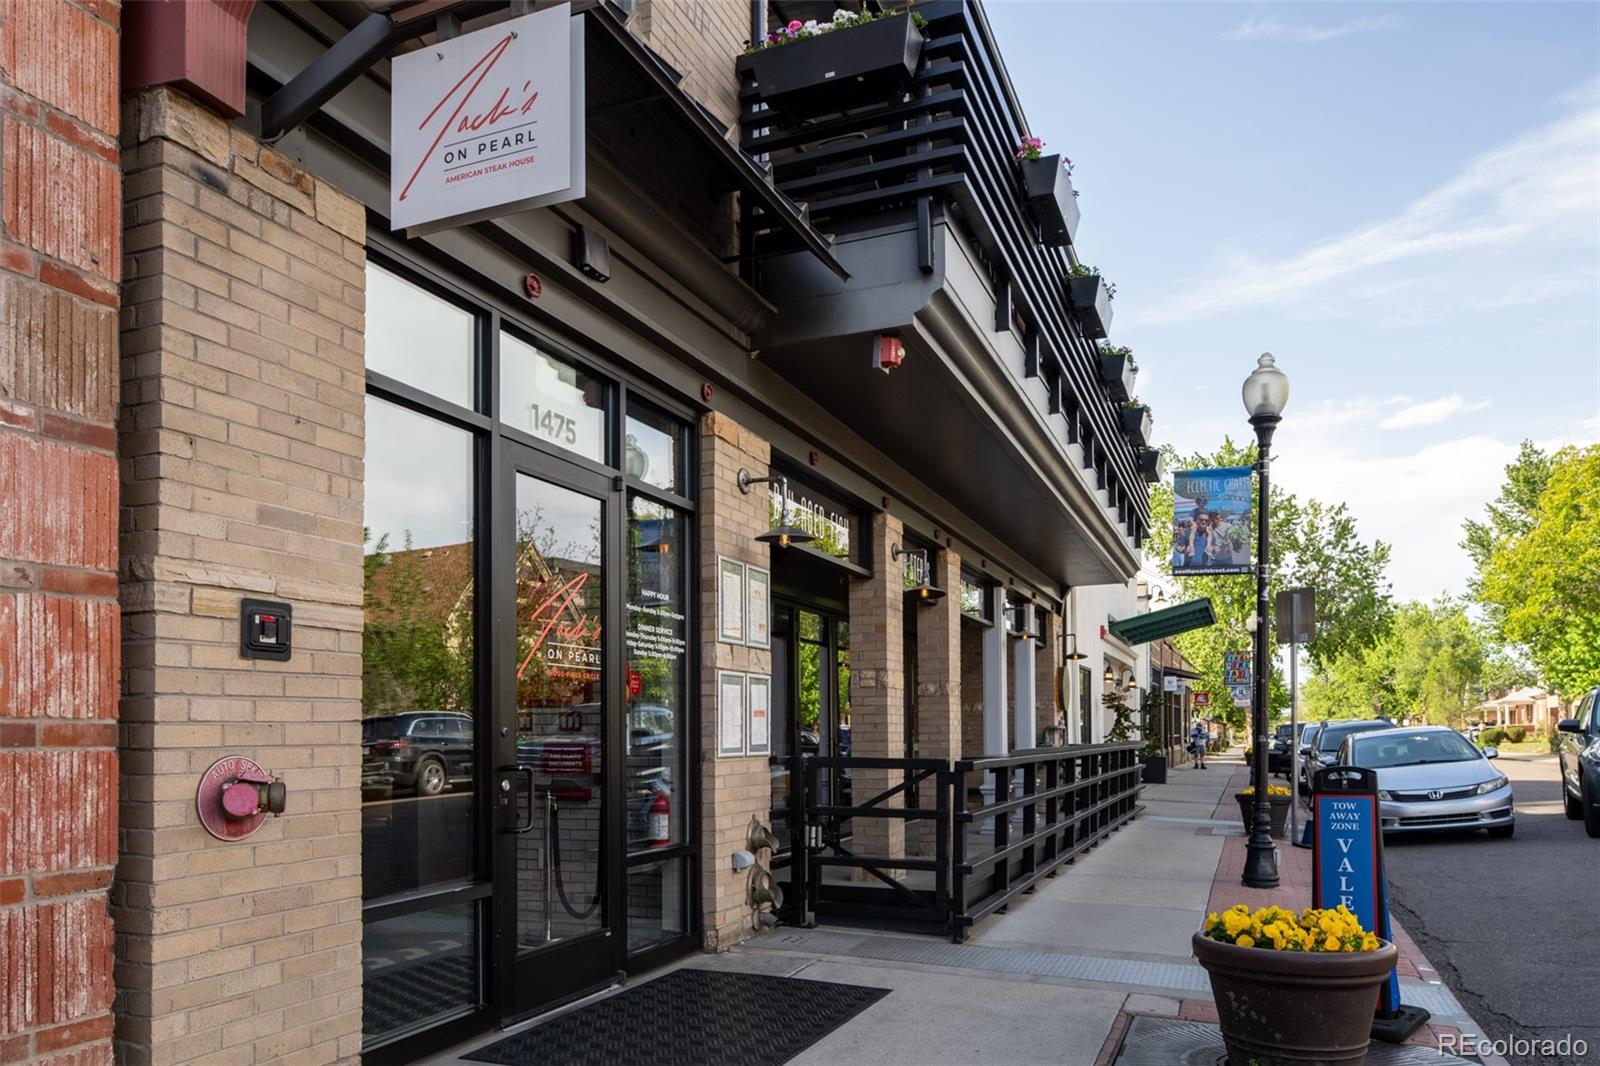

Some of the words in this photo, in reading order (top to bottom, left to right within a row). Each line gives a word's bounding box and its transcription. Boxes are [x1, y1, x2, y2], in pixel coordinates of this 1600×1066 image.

[399, 34, 539, 202] Jack's
[444, 147, 468, 165] ON
[478, 130, 536, 156] PEARL
[445, 169, 484, 185] AMERICAN
[484, 162, 508, 176] STEAK
[508, 155, 536, 170] HOUSE
[531, 403, 577, 445] 1475
[1186, 479, 1223, 494] ECLECTIC
[641, 589, 656, 599] HAPPY
[656, 592, 670, 601] HOUR
[637, 623, 655, 633] DINNER
[655, 626, 673, 636] SERVICE
[547, 648, 563, 660] ON
[568, 651, 601, 664] PEARL
[211, 759, 235, 780] AUTO
[1332, 801, 1357, 810] TOW
[1329, 812, 1361, 821] AWAY
[1330, 822, 1360, 831] ZONE
[1336, 838, 1355, 911] VALE
